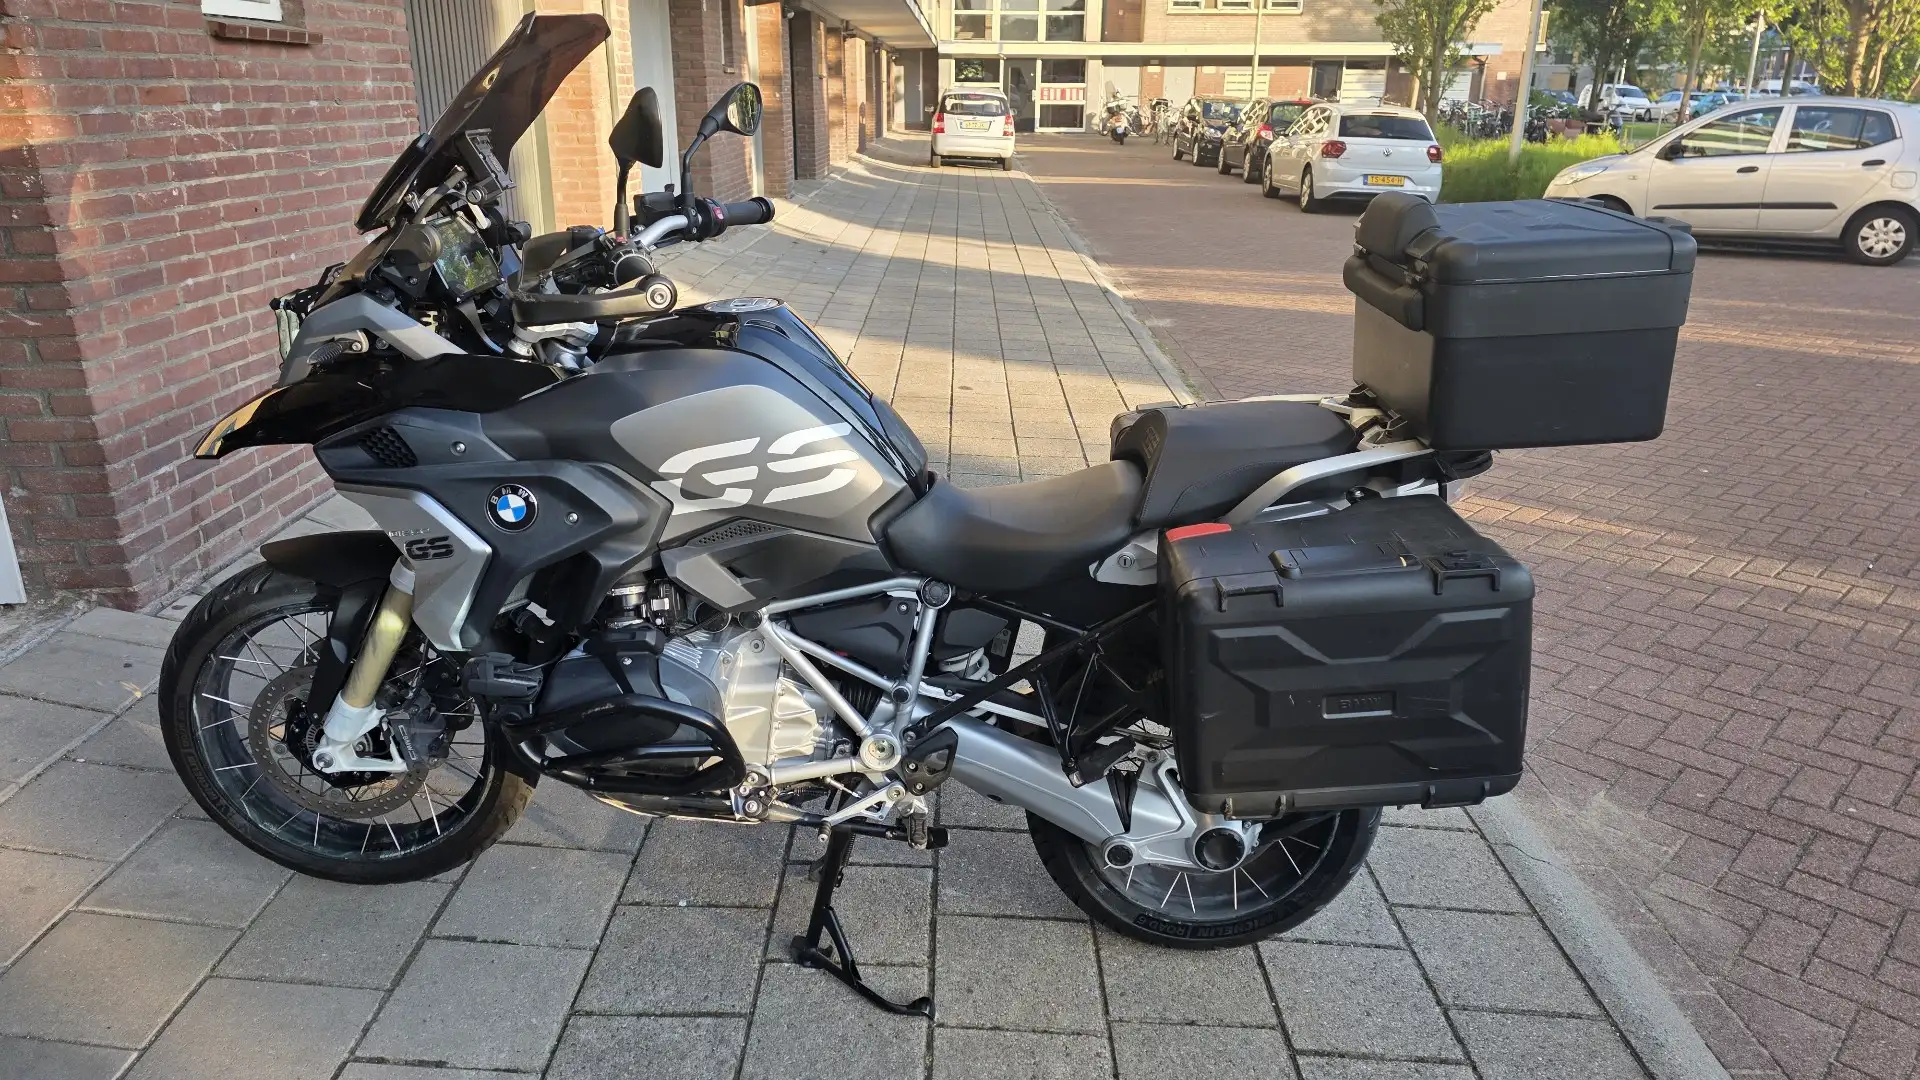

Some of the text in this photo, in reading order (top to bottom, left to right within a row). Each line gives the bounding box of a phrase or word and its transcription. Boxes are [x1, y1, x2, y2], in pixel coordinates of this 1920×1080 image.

[650, 422, 861, 517] GS
[490, 487, 528, 505] BMW
[403, 536, 455, 560] GS
[402, 735, 413, 751] BMW
[1148, 918, 1187, 937] ROAD
